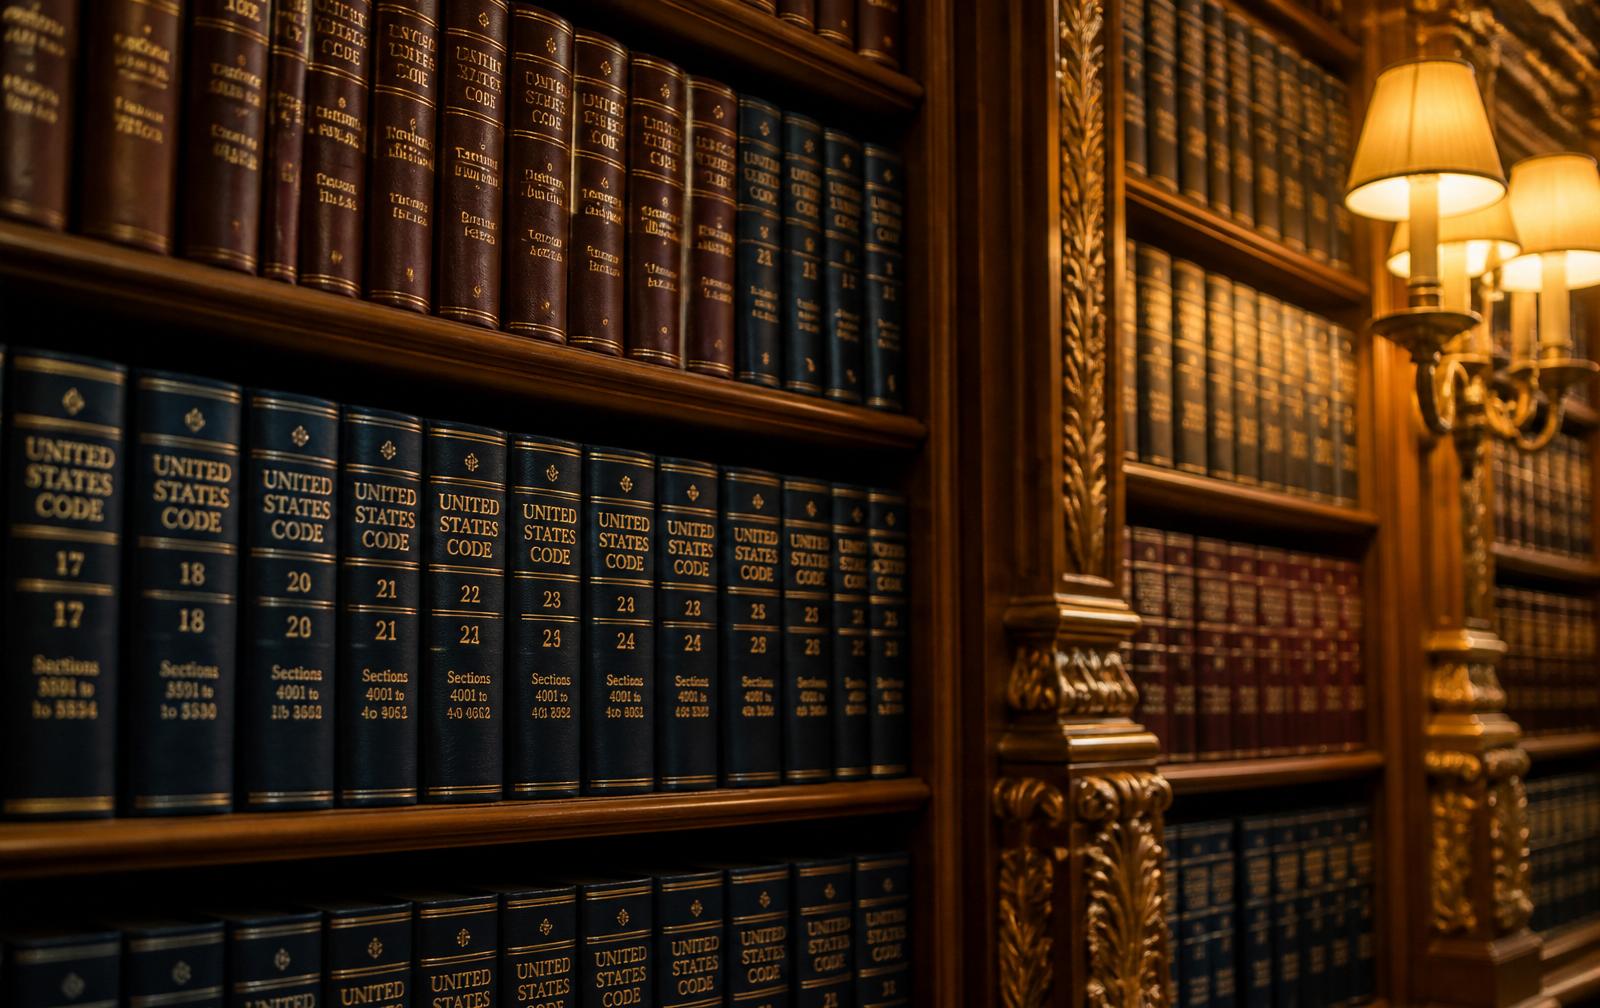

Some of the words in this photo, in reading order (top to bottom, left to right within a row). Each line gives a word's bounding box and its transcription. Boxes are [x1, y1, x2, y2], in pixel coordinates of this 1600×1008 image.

[25, 436, 116, 470] UNITED
[153, 454, 232, 483] UNITED
[25, 463, 114, 497] STATES
[263, 469, 333, 496] UNITED
[153, 479, 230, 508] STATES
[354, 482, 417, 507] UNITED
[35, 492, 104, 522] CODE
[263, 494, 332, 520] STATES
[438, 493, 500, 516] UNITED
[523, 503, 577, 524] UNITED
[161, 506, 223, 533] CODE
[355, 505, 416, 529] STATES
[439, 516, 499, 537] STATES
[598, 512, 650, 532] UNITED
[271, 519, 324, 543] CODE
[524, 524, 576, 545] STATES
[667, 520, 715, 539] UNITED
[734, 527, 778, 546] UNITED
[362, 530, 410, 551] CODE
[447, 539, 493, 559] CODE
[599, 532, 649, 552] STATES
[668, 539, 714, 558] STATES
[790, 533, 830, 550] UNITED
[56, 550, 85, 577] 17
[530, 546, 571, 565] CODE
[605, 553, 645, 571] CODE
[735, 546, 778, 564] STATES
[791, 551, 829, 569] STATES
[180, 562, 206, 586] 18
[674, 559, 710, 577] CODE
[740, 565, 774, 582] CODE
[796, 569, 827, 586] CODE
[286, 571, 312, 593] 20
[376, 579, 397, 599] 21
[460, 585, 481, 603] 22
[543, 591, 561, 608] 23
[53, 601, 85, 628] 17
[179, 608, 206, 633] 18
[285, 615, 312, 638] 20
[375, 620, 397, 641] 21
[617, 632, 635, 650] 24
[271, 664, 323, 682] Sections
[362, 668, 409, 683] Sections
[447, 670, 491, 685] Sections
[531, 672, 572, 686] Sections
[606, 674, 644, 687] Sections
[366, 687, 393, 701] 4001
[395, 689, 405, 701] to
[450, 688, 476, 702] 4001
[478, 691, 488, 702] to
[535, 689, 558, 702] 4001
[740, 925, 787, 946] UNITED
[807, 916, 851, 936] UNITED
[671, 936, 720, 956] UNITED
[808, 935, 850, 954] STATES
[594, 946, 648, 968] UNITED
[741, 945, 785, 965] STATES
[814, 953, 846, 972] CODE
[516, 957, 571, 980] UNITED
[672, 955, 719, 976] STATES
[747, 964, 781, 984] CODE
[430, 968, 491, 992] UNITED
[596, 966, 647, 988] STATES
[678, 976, 714, 995] CODE
[340, 980, 405, 1006] UNITED
[433, 990, 490, 1008] STATES
[517, 978, 570, 1001] STATES
[603, 987, 641, 1008] CODE
